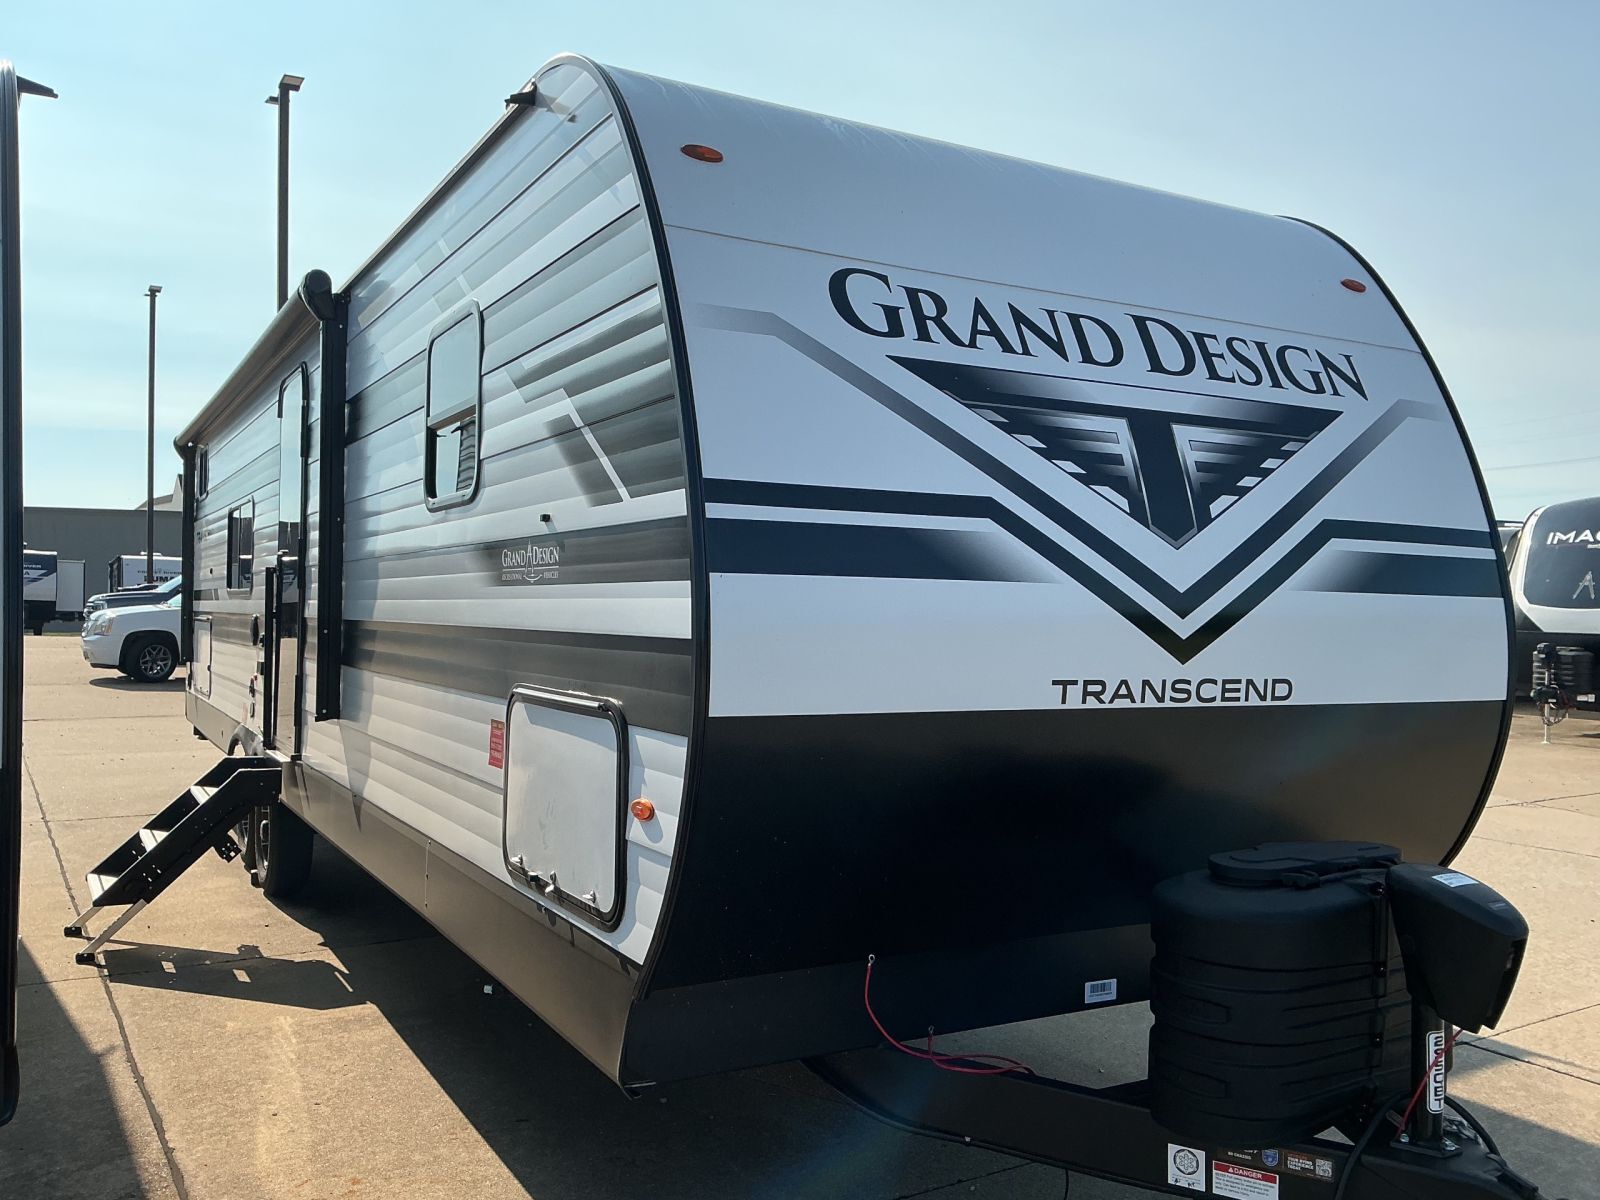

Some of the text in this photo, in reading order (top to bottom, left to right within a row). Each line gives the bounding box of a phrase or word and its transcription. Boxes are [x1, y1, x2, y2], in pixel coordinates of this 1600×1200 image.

[828, 267, 1368, 401] GRAND DESIGN
[501, 546, 560, 567] GRAND DESIGN
[1051, 678, 1294, 705] TRANSCEND
[1233, 1167, 1263, 1180] DANGER
